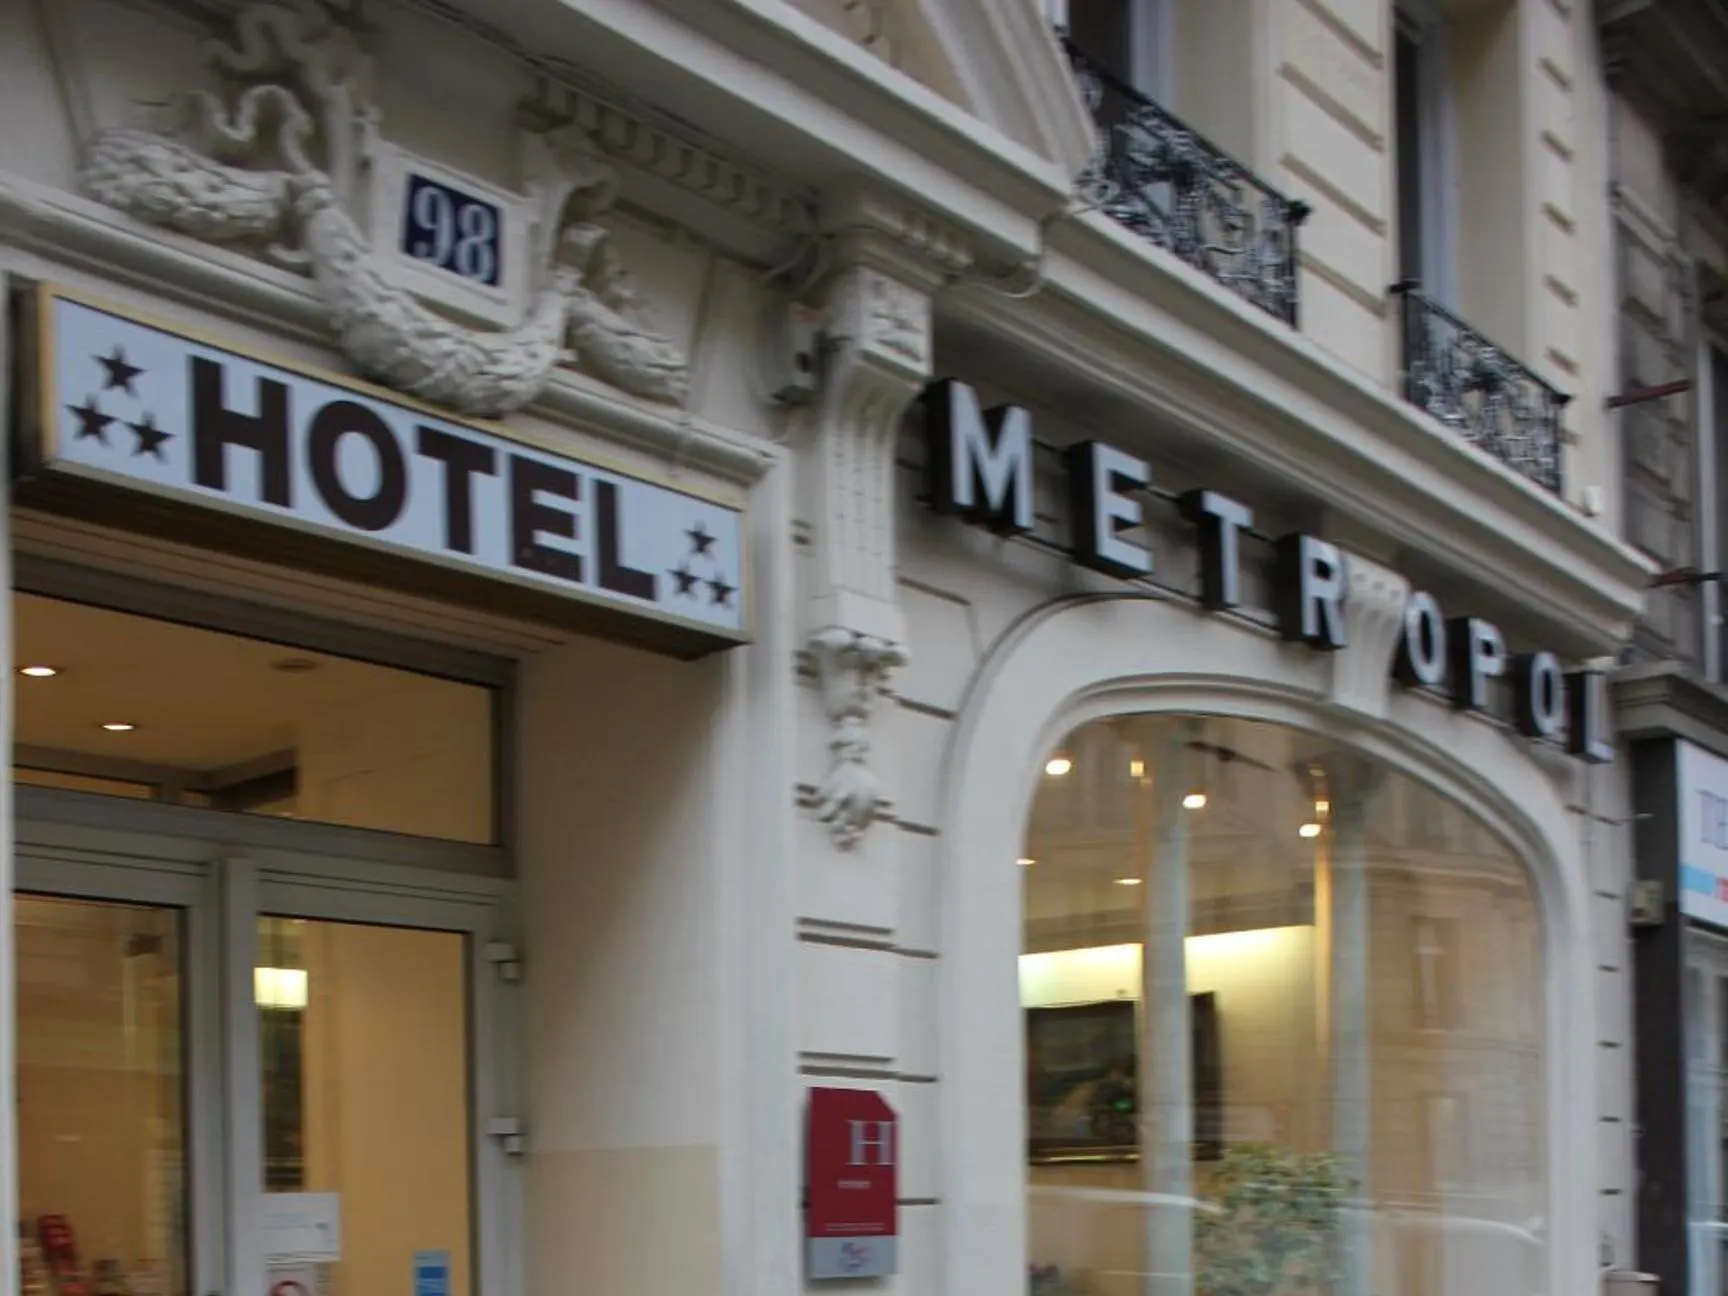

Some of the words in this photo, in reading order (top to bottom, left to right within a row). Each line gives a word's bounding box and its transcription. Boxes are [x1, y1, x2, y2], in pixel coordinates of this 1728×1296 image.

[412, 185, 494, 284] 98
[187, 352, 658, 602] HOTEL
[938, 378, 1613, 763] METROPOL
[846, 1119, 898, 1166] H
